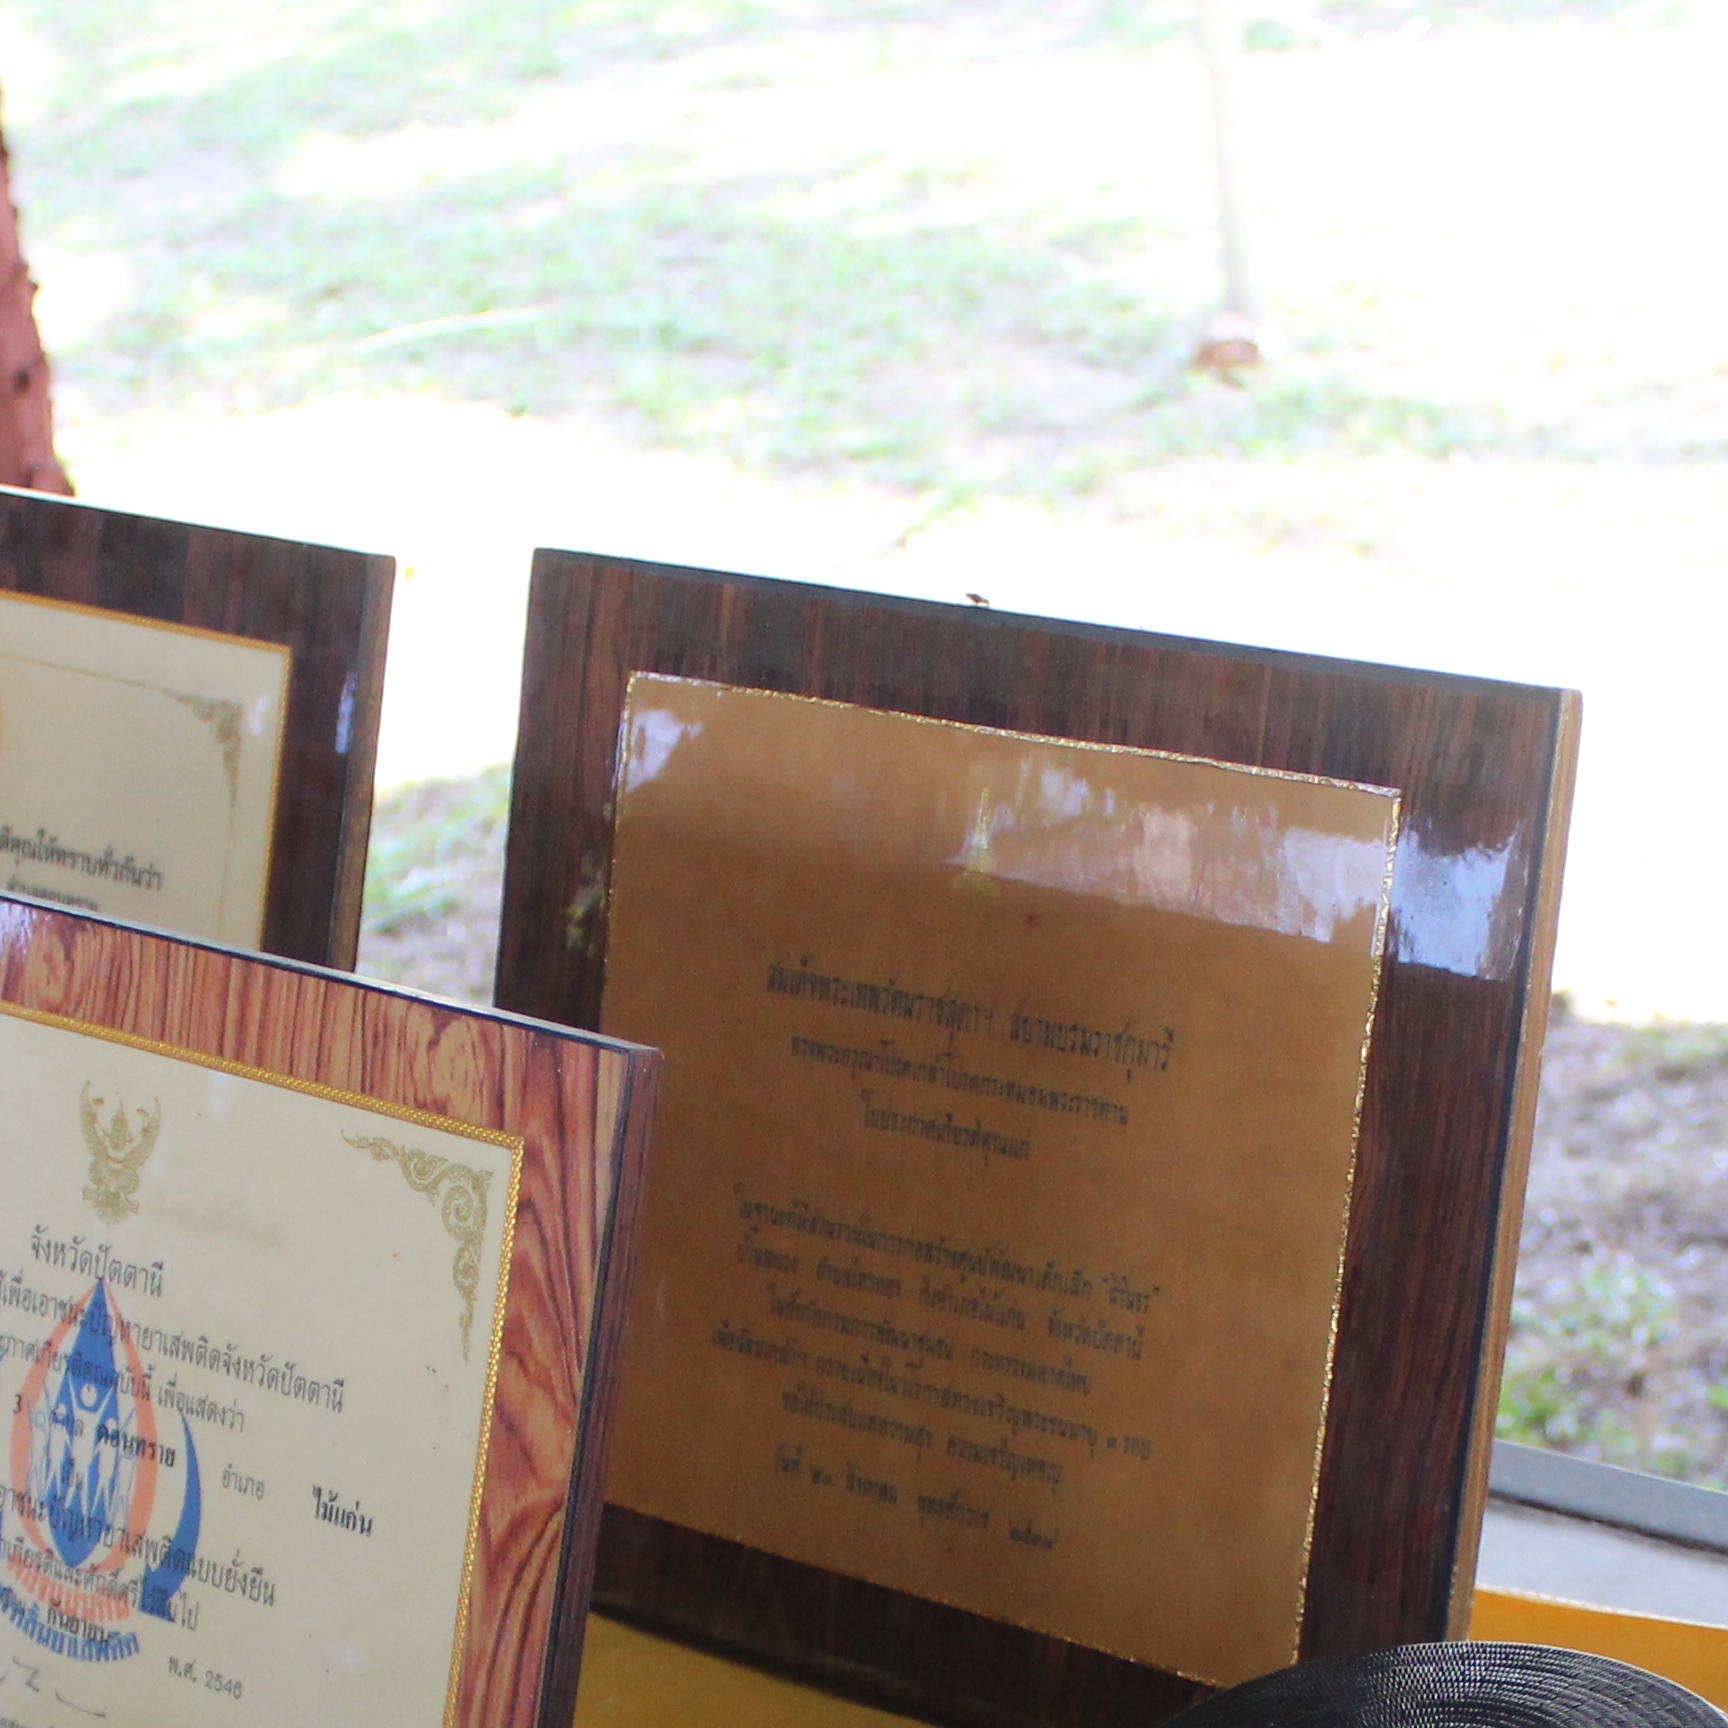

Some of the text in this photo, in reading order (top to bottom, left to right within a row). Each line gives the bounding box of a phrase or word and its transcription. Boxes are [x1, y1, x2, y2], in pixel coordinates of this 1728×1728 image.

[31, 1225, 164, 1298] จังหวัดปัตตานี
[158, 1373, 245, 1432] เพื่อแสดงว่า
[13, 1394, 24, 1418] 3
[95, 1420, 176, 1467] ดอนทราย
[221, 1462, 266, 1501] อำเภอ
[312, 1485, 373, 1537] ไม้แก่น
[168, 1656, 198, 1683] พ.ศ.
